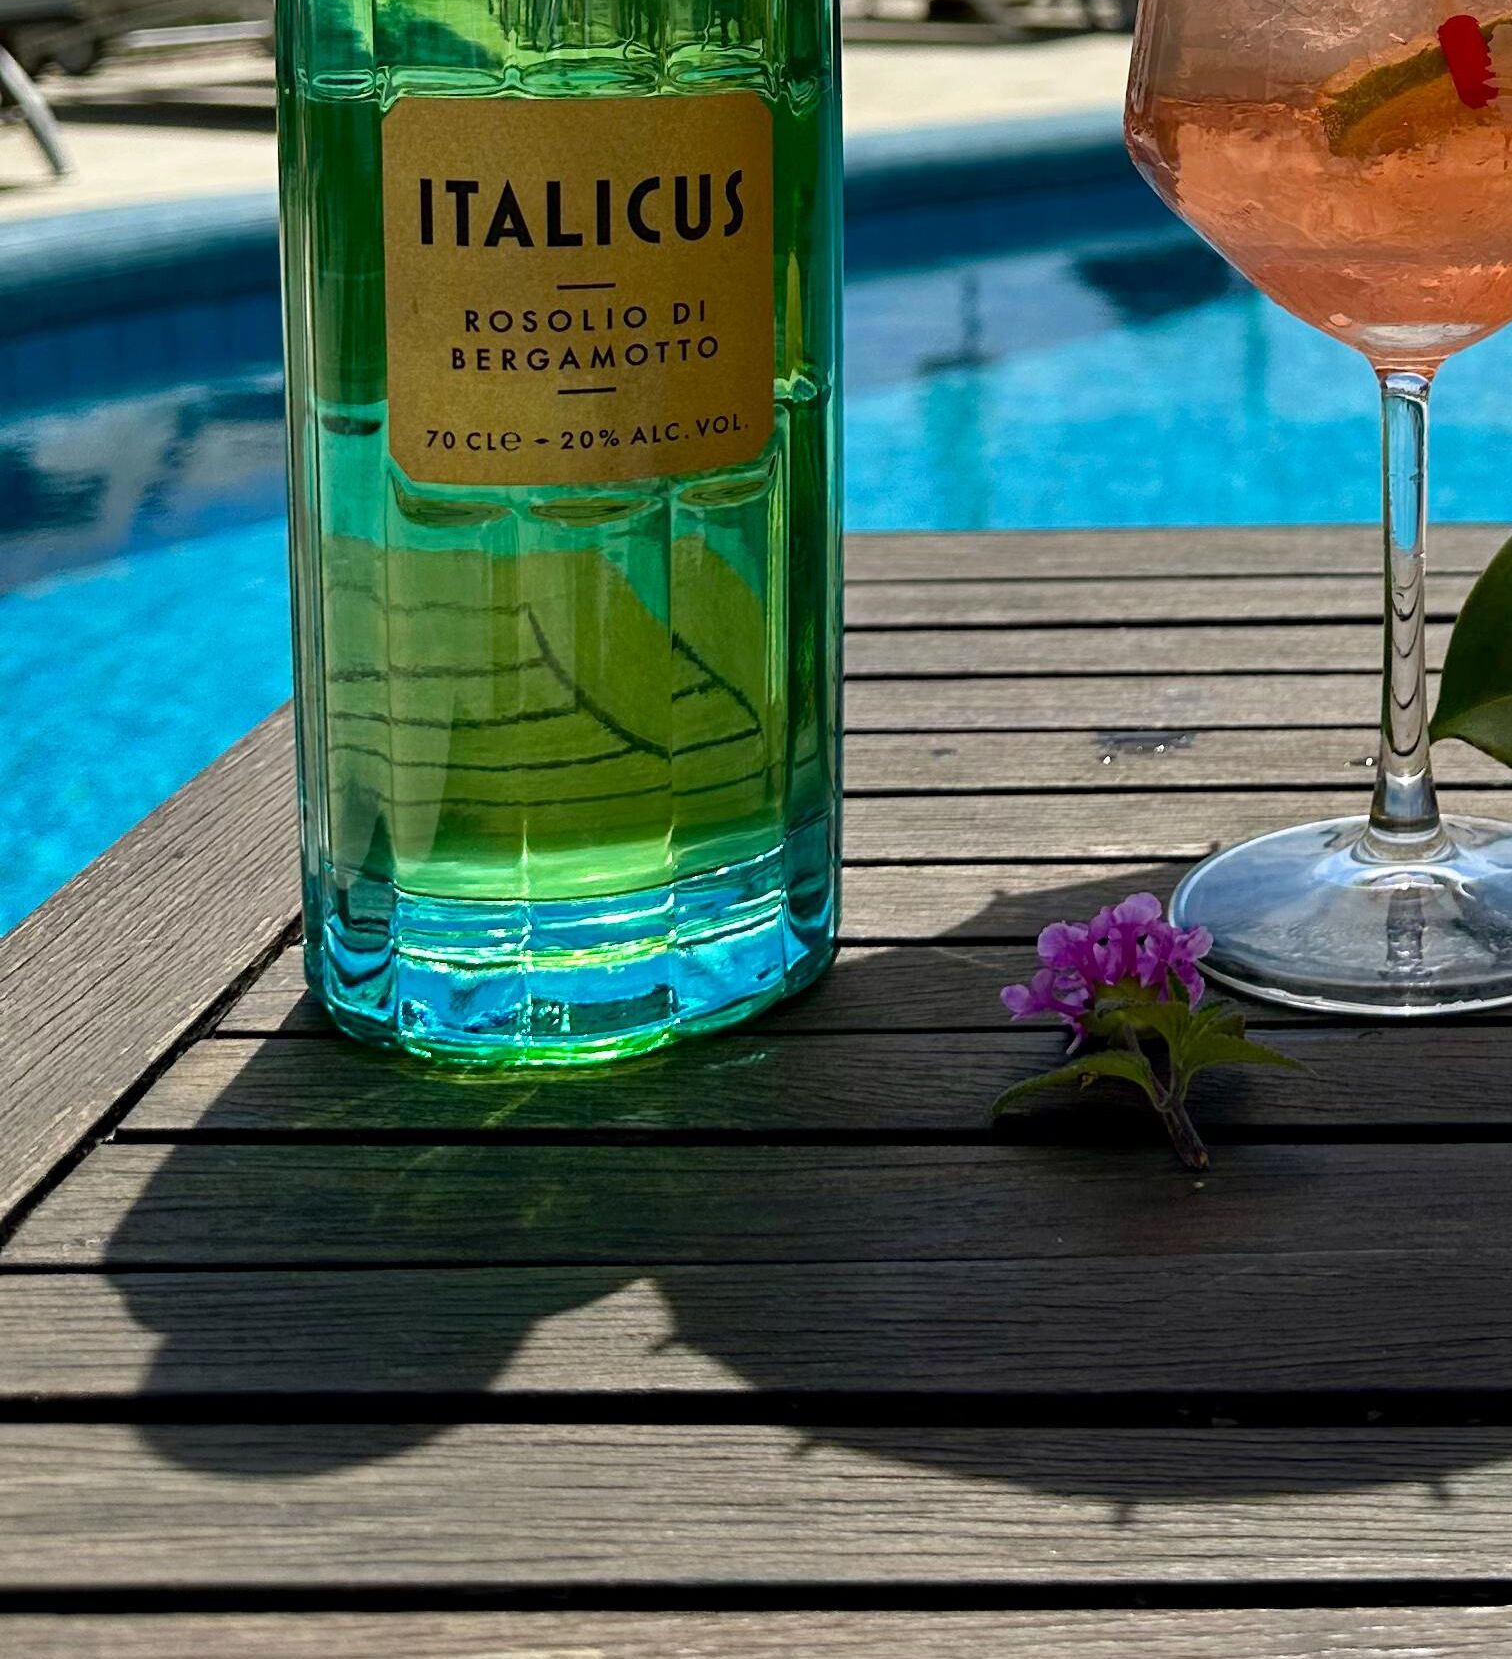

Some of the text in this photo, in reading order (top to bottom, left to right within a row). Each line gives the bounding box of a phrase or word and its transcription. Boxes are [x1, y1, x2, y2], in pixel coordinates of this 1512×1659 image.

[419, 169, 744, 247] ITALICUS
[464, 300, 706, 333] ROSOLIO DI
[451, 335, 719, 372] BERGAMOTTO
[425, 429, 456, 450] 70
[560, 428, 620, 450] 20%
[630, 422, 690, 445] ALC.
[695, 413, 749, 439] VOL.
